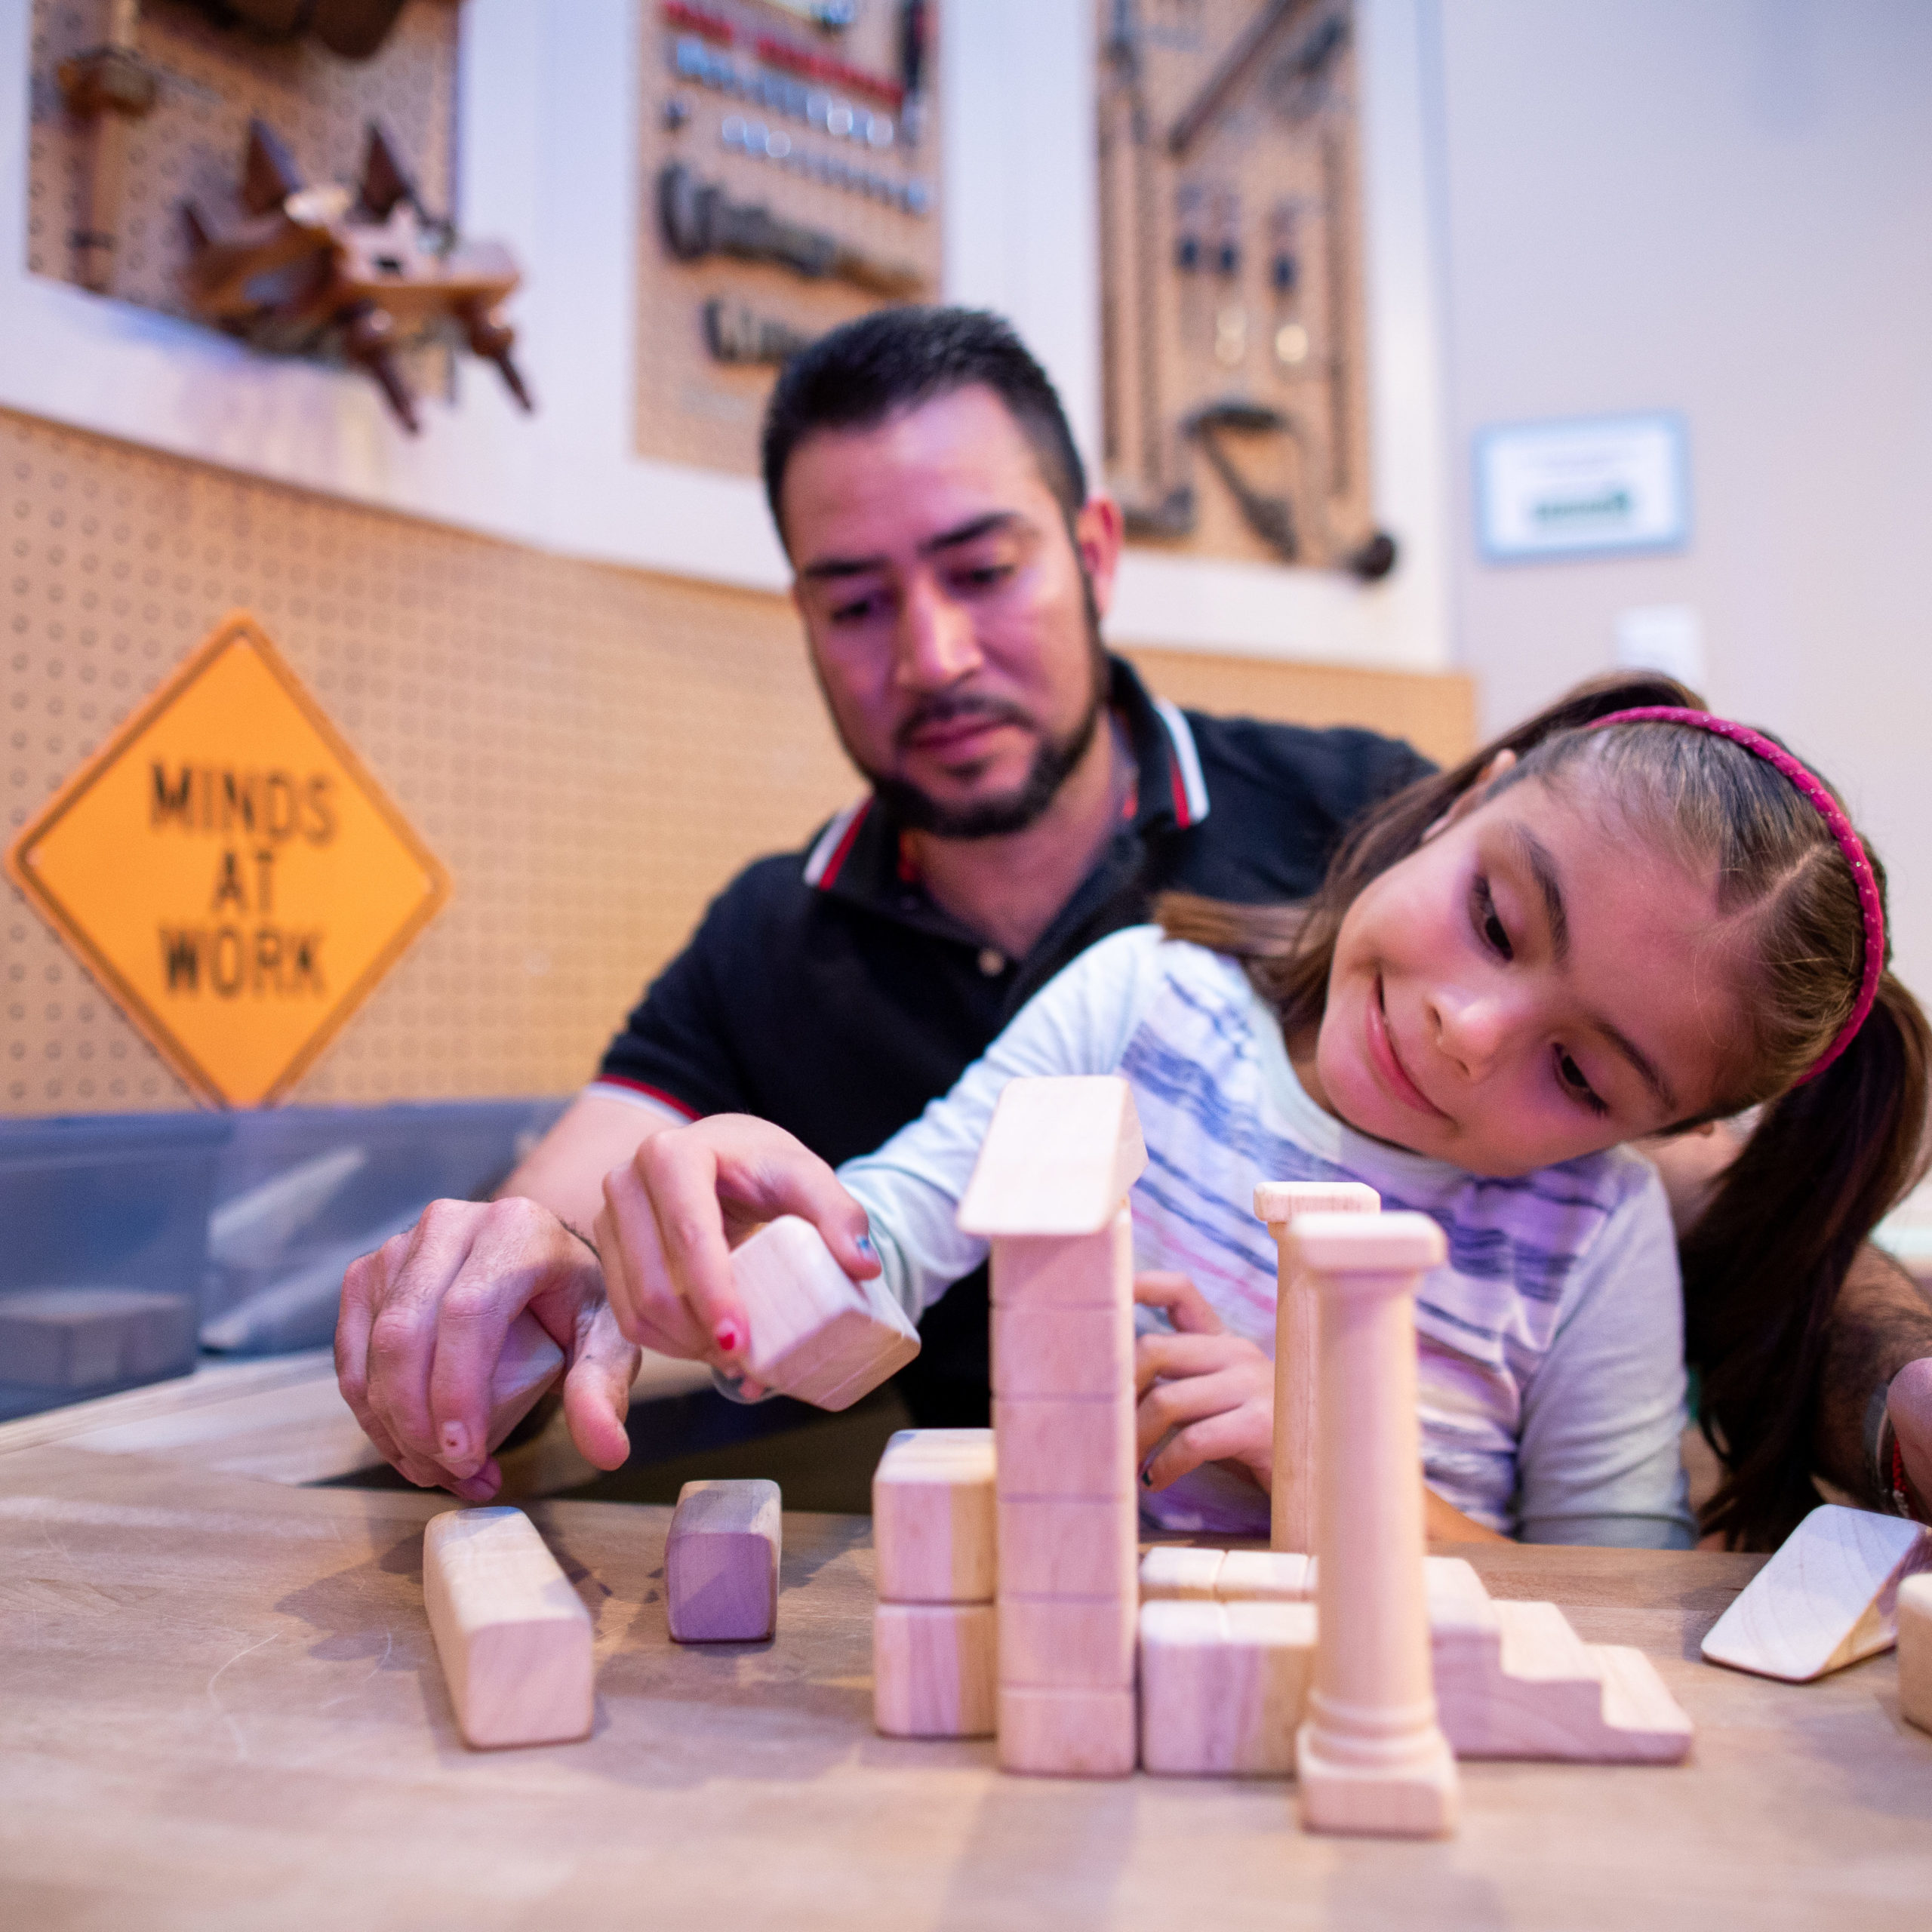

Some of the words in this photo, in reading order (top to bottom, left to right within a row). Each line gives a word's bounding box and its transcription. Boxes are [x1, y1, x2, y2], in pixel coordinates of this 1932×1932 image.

[150, 763, 337, 846] MINDS
[211, 848, 274, 914] AT
[158, 926, 327, 997] WORK
